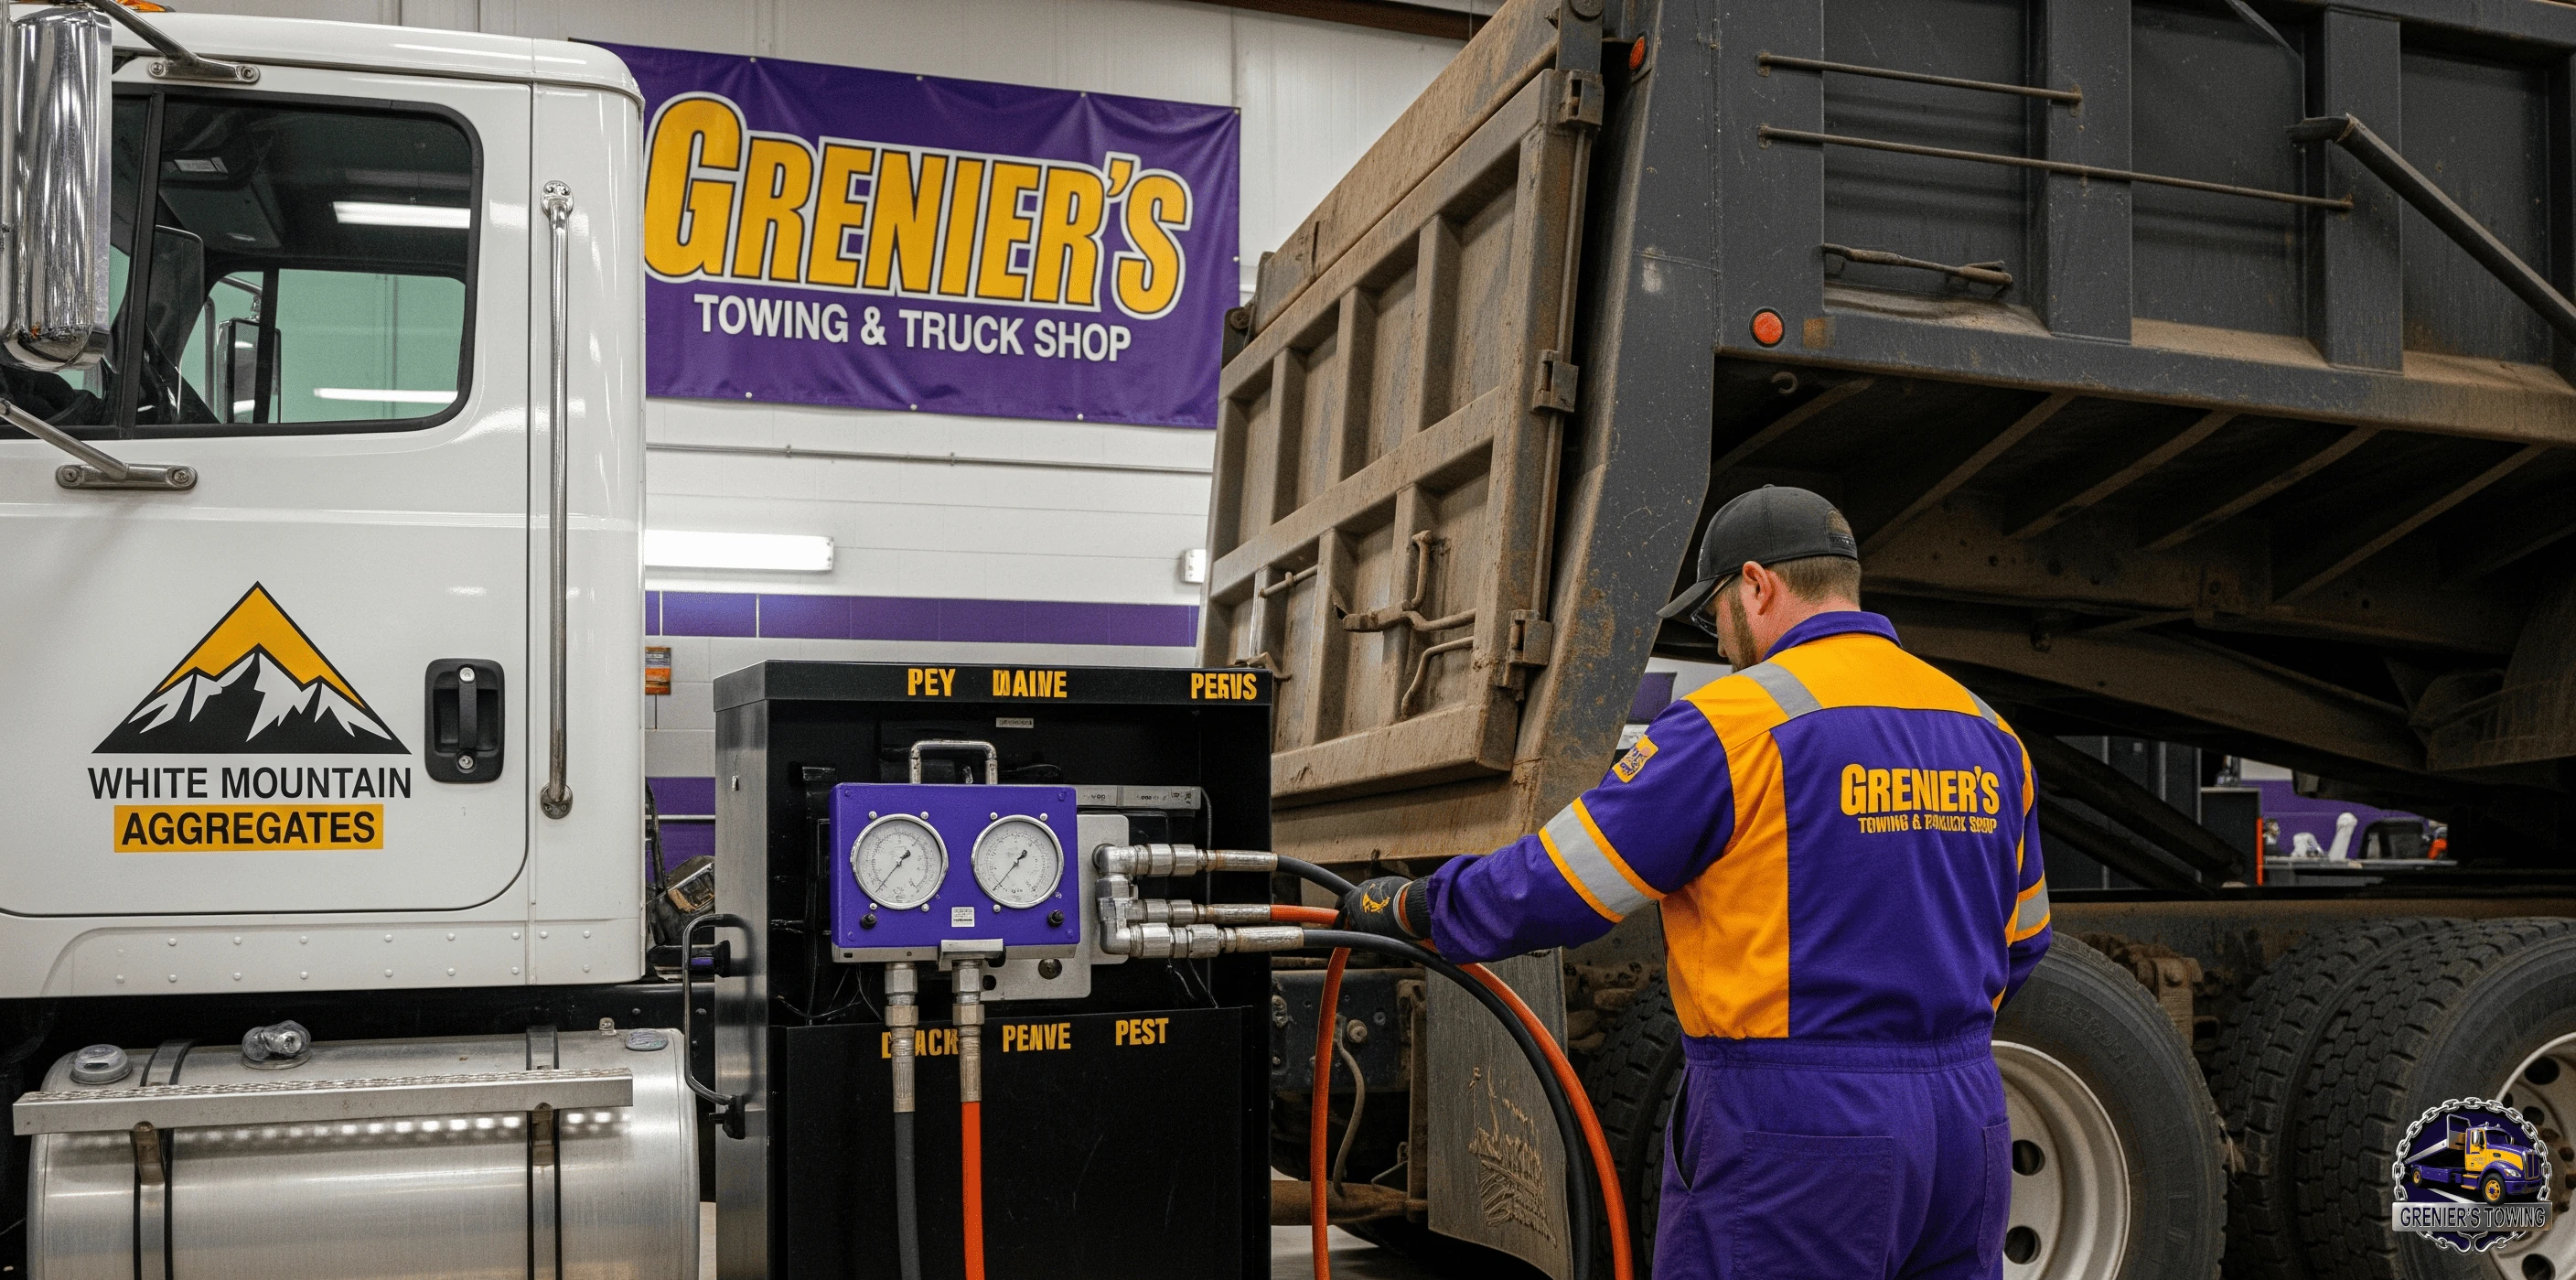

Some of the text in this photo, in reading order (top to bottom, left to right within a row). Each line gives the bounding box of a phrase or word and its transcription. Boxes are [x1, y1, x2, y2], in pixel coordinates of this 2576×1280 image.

[644, 93, 1192, 318] GRENIER'S
[693, 294, 1132, 362] TOWING & TRUCK SHOP
[907, 668, 957, 697] PEY
[87, 767, 412, 799] WHITE MOUNTAIN
[1841, 763, 2001, 816] GRENIER'S
[122, 811, 376, 845] AGGREGATES
[1115, 1017, 1170, 1046] PEST
